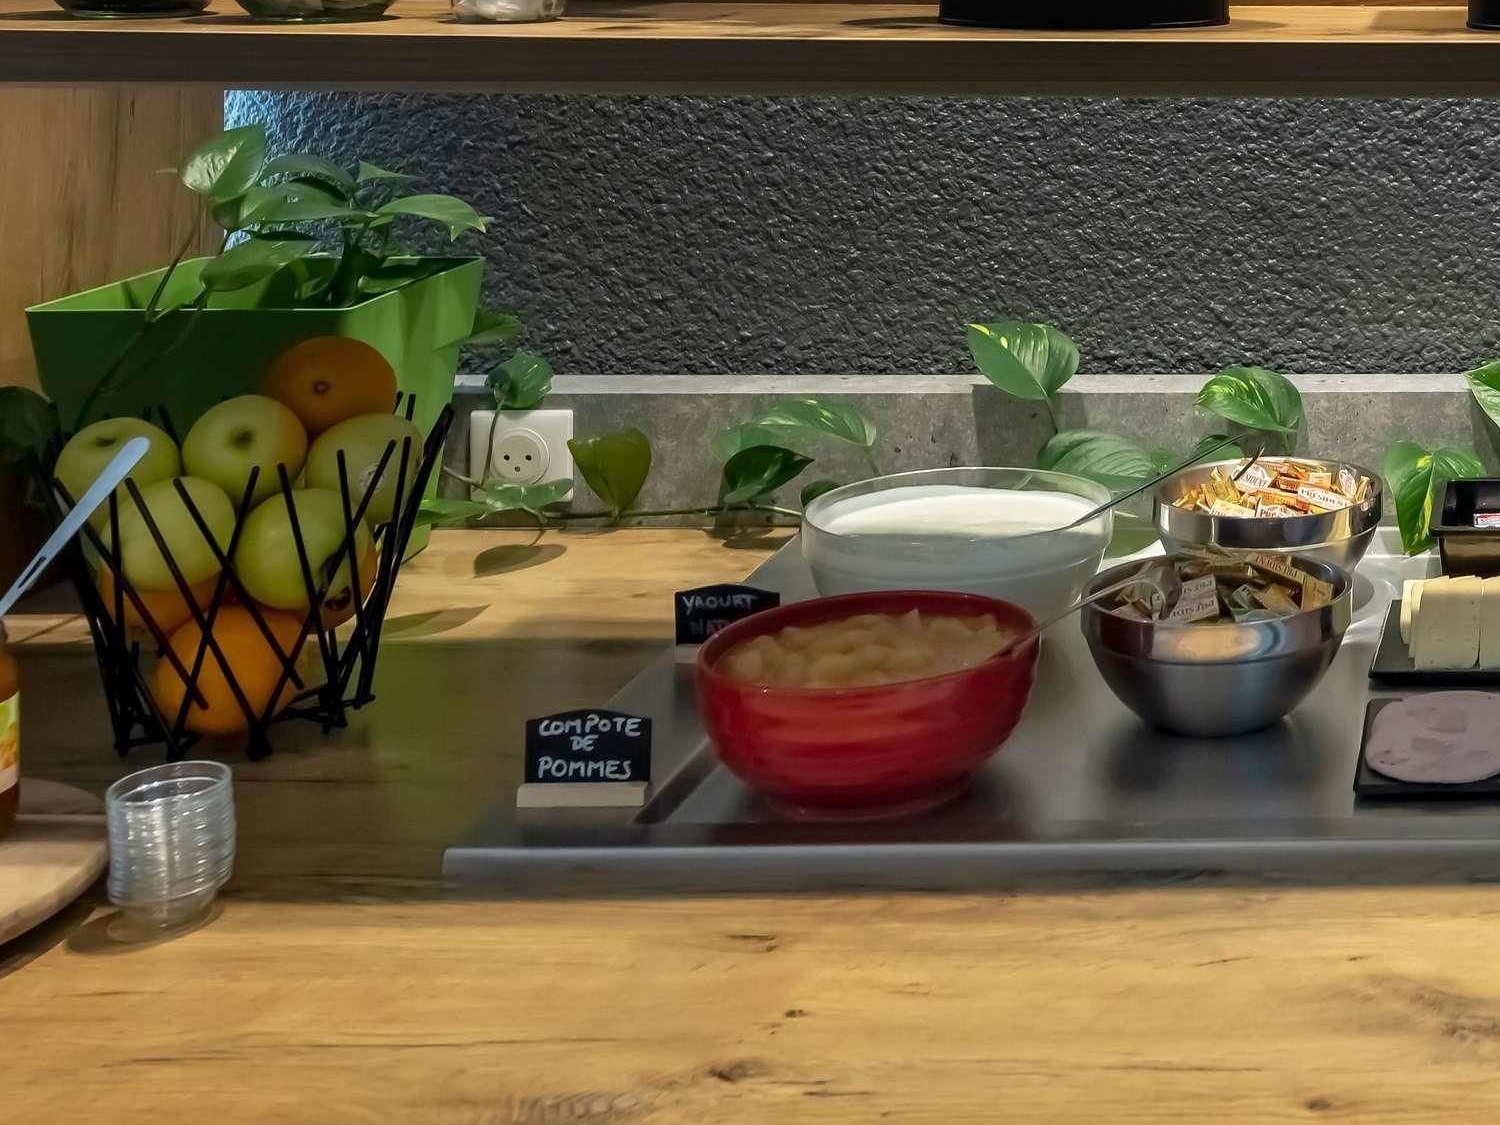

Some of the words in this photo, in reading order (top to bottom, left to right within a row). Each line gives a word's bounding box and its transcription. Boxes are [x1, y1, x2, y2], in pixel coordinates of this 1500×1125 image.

[682, 594, 758, 616] YAOURT
[539, 714, 642, 737] COMPOTE
[570, 735, 600, 751] DE
[537, 756, 632, 780] POMMES
